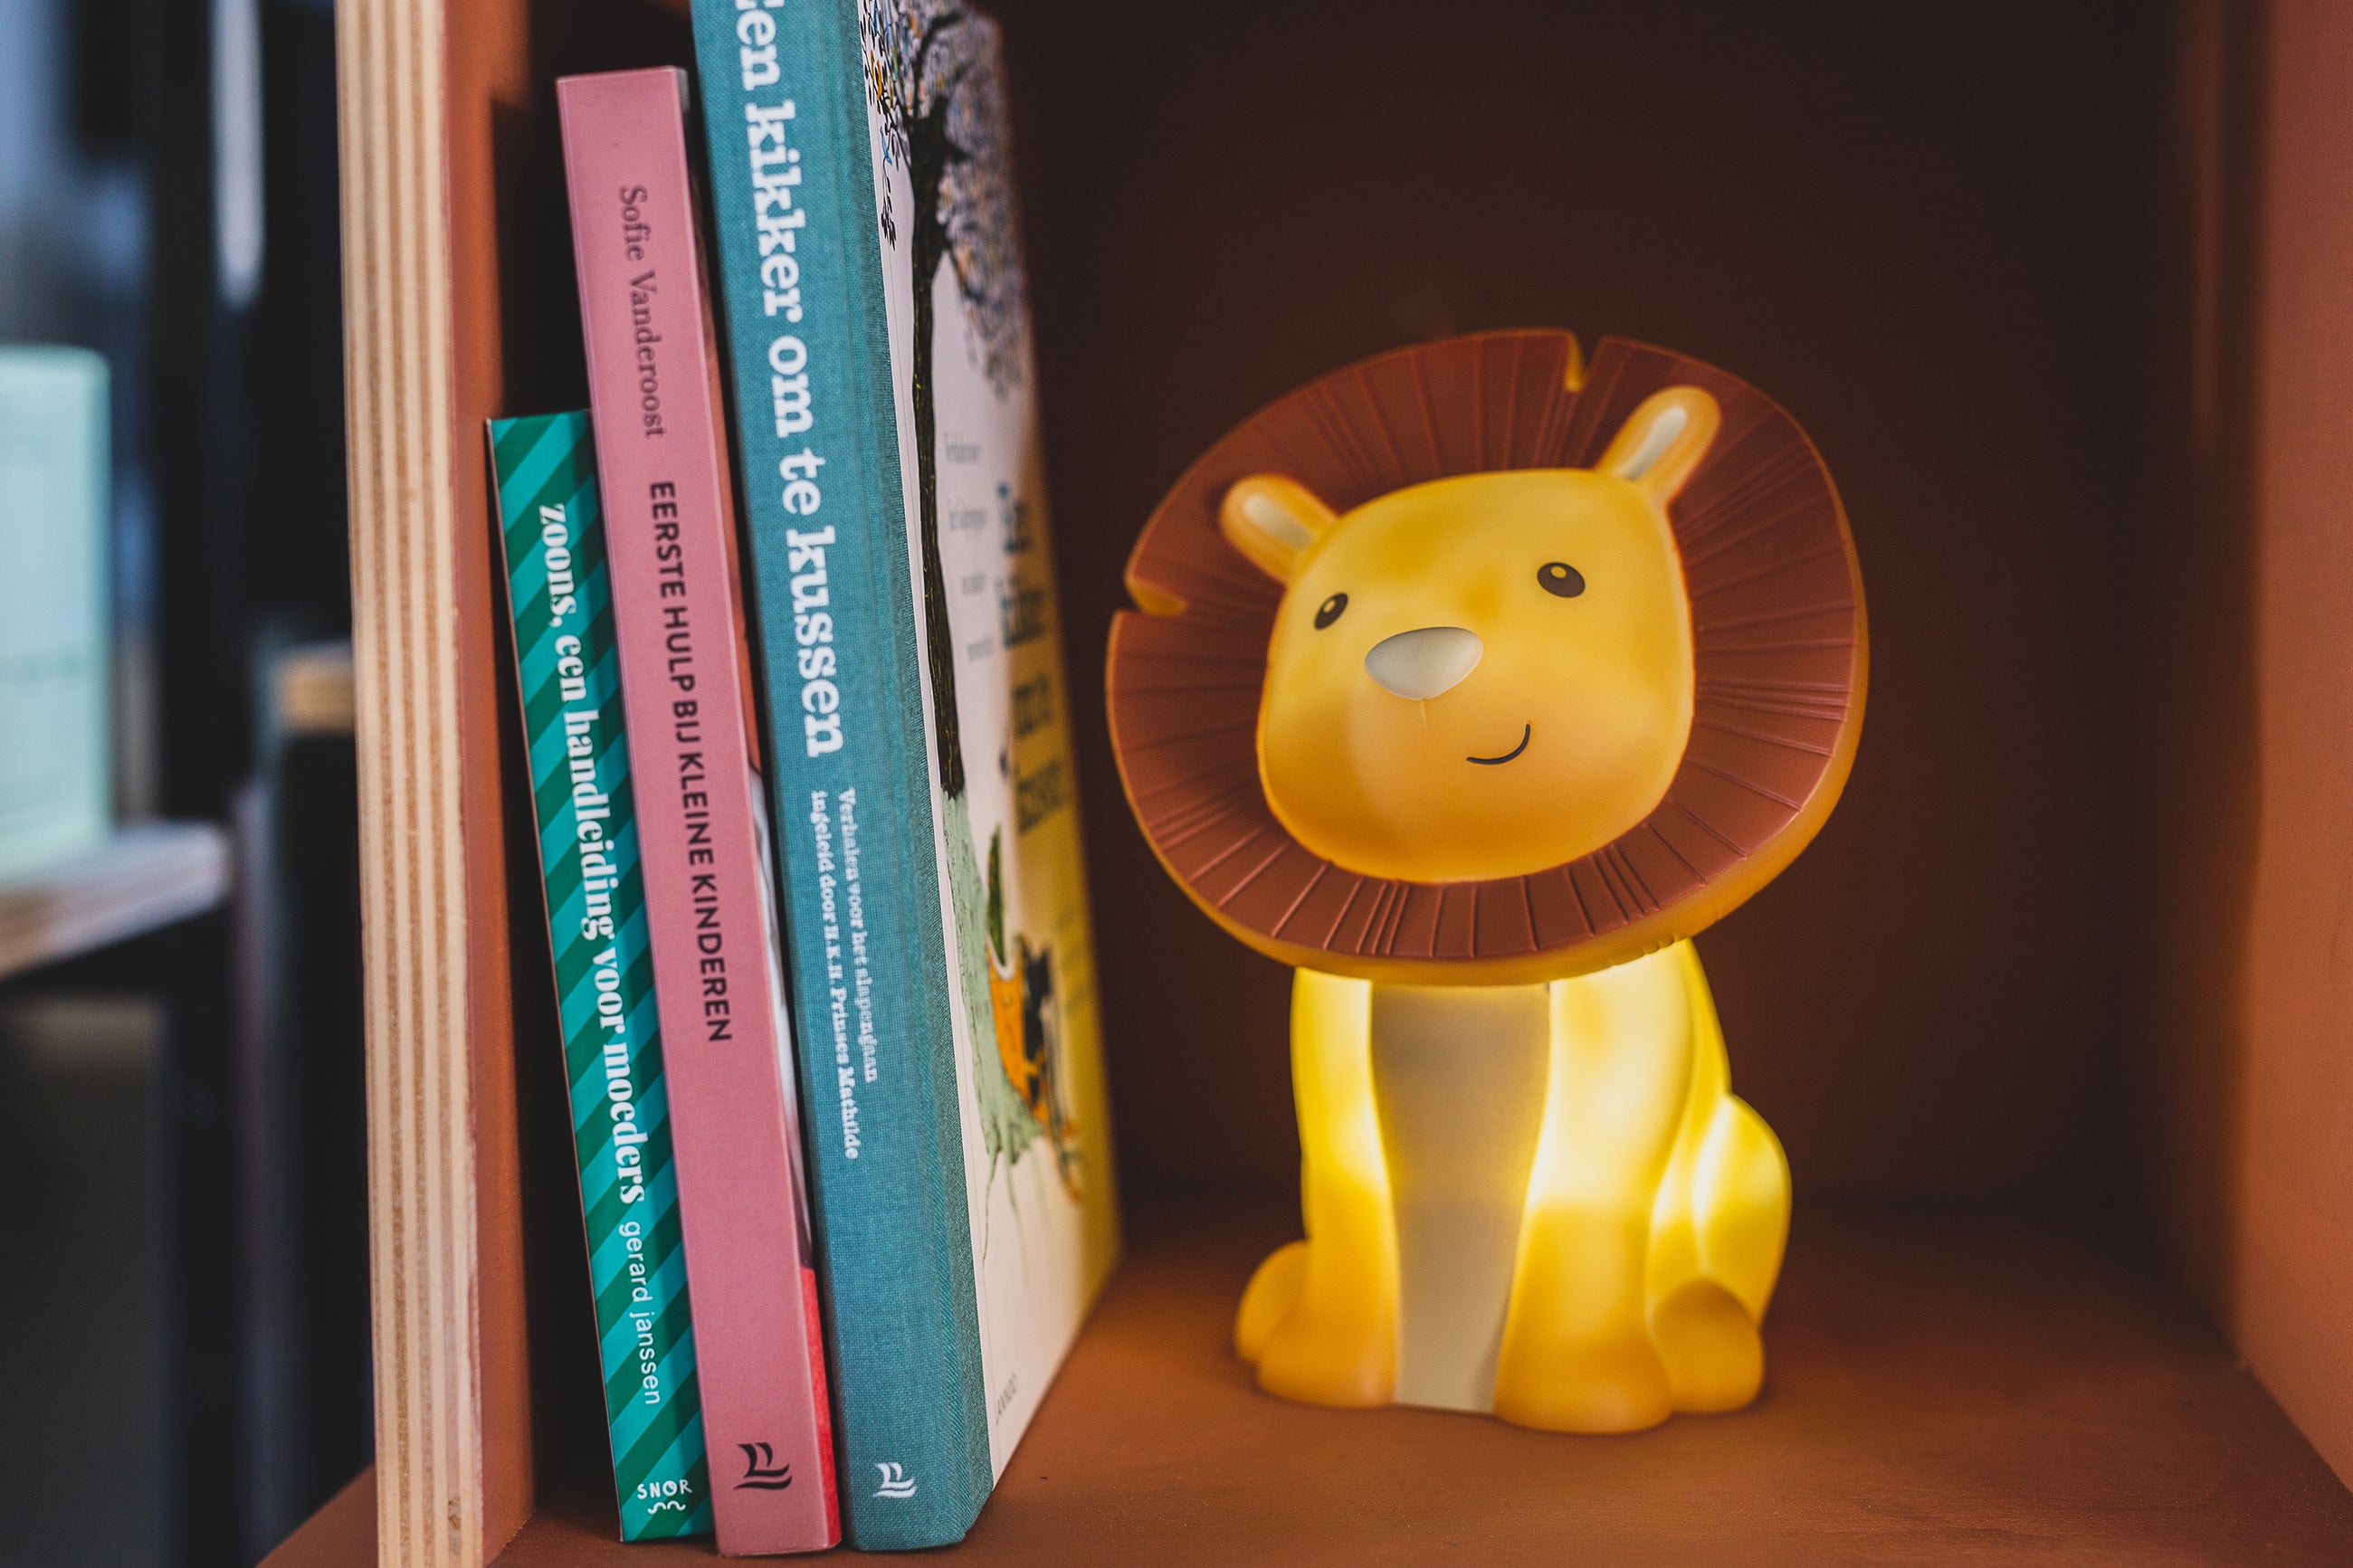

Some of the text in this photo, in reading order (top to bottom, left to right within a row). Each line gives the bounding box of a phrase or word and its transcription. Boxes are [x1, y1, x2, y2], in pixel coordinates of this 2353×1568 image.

[619, 185, 666, 439] Sofie Vanderoost
[735, 0, 844, 757] en kikker om te kussen
[650, 480, 733, 1042] EERSTE HULP BIJ KLEINE KINDEREN
[810, 790, 836, 873] ingeleid
[538, 503, 662, 1405] zoons, een handleiding voor moeders gerard janssen
[819, 873, 837, 923] door
[838, 787, 878, 1084] Verhalen voor het slapengaan
[830, 988, 849, 1064] Prinses
[837, 1066, 861, 1159] Mathilde
[636, 1478, 693, 1500] SNOR
